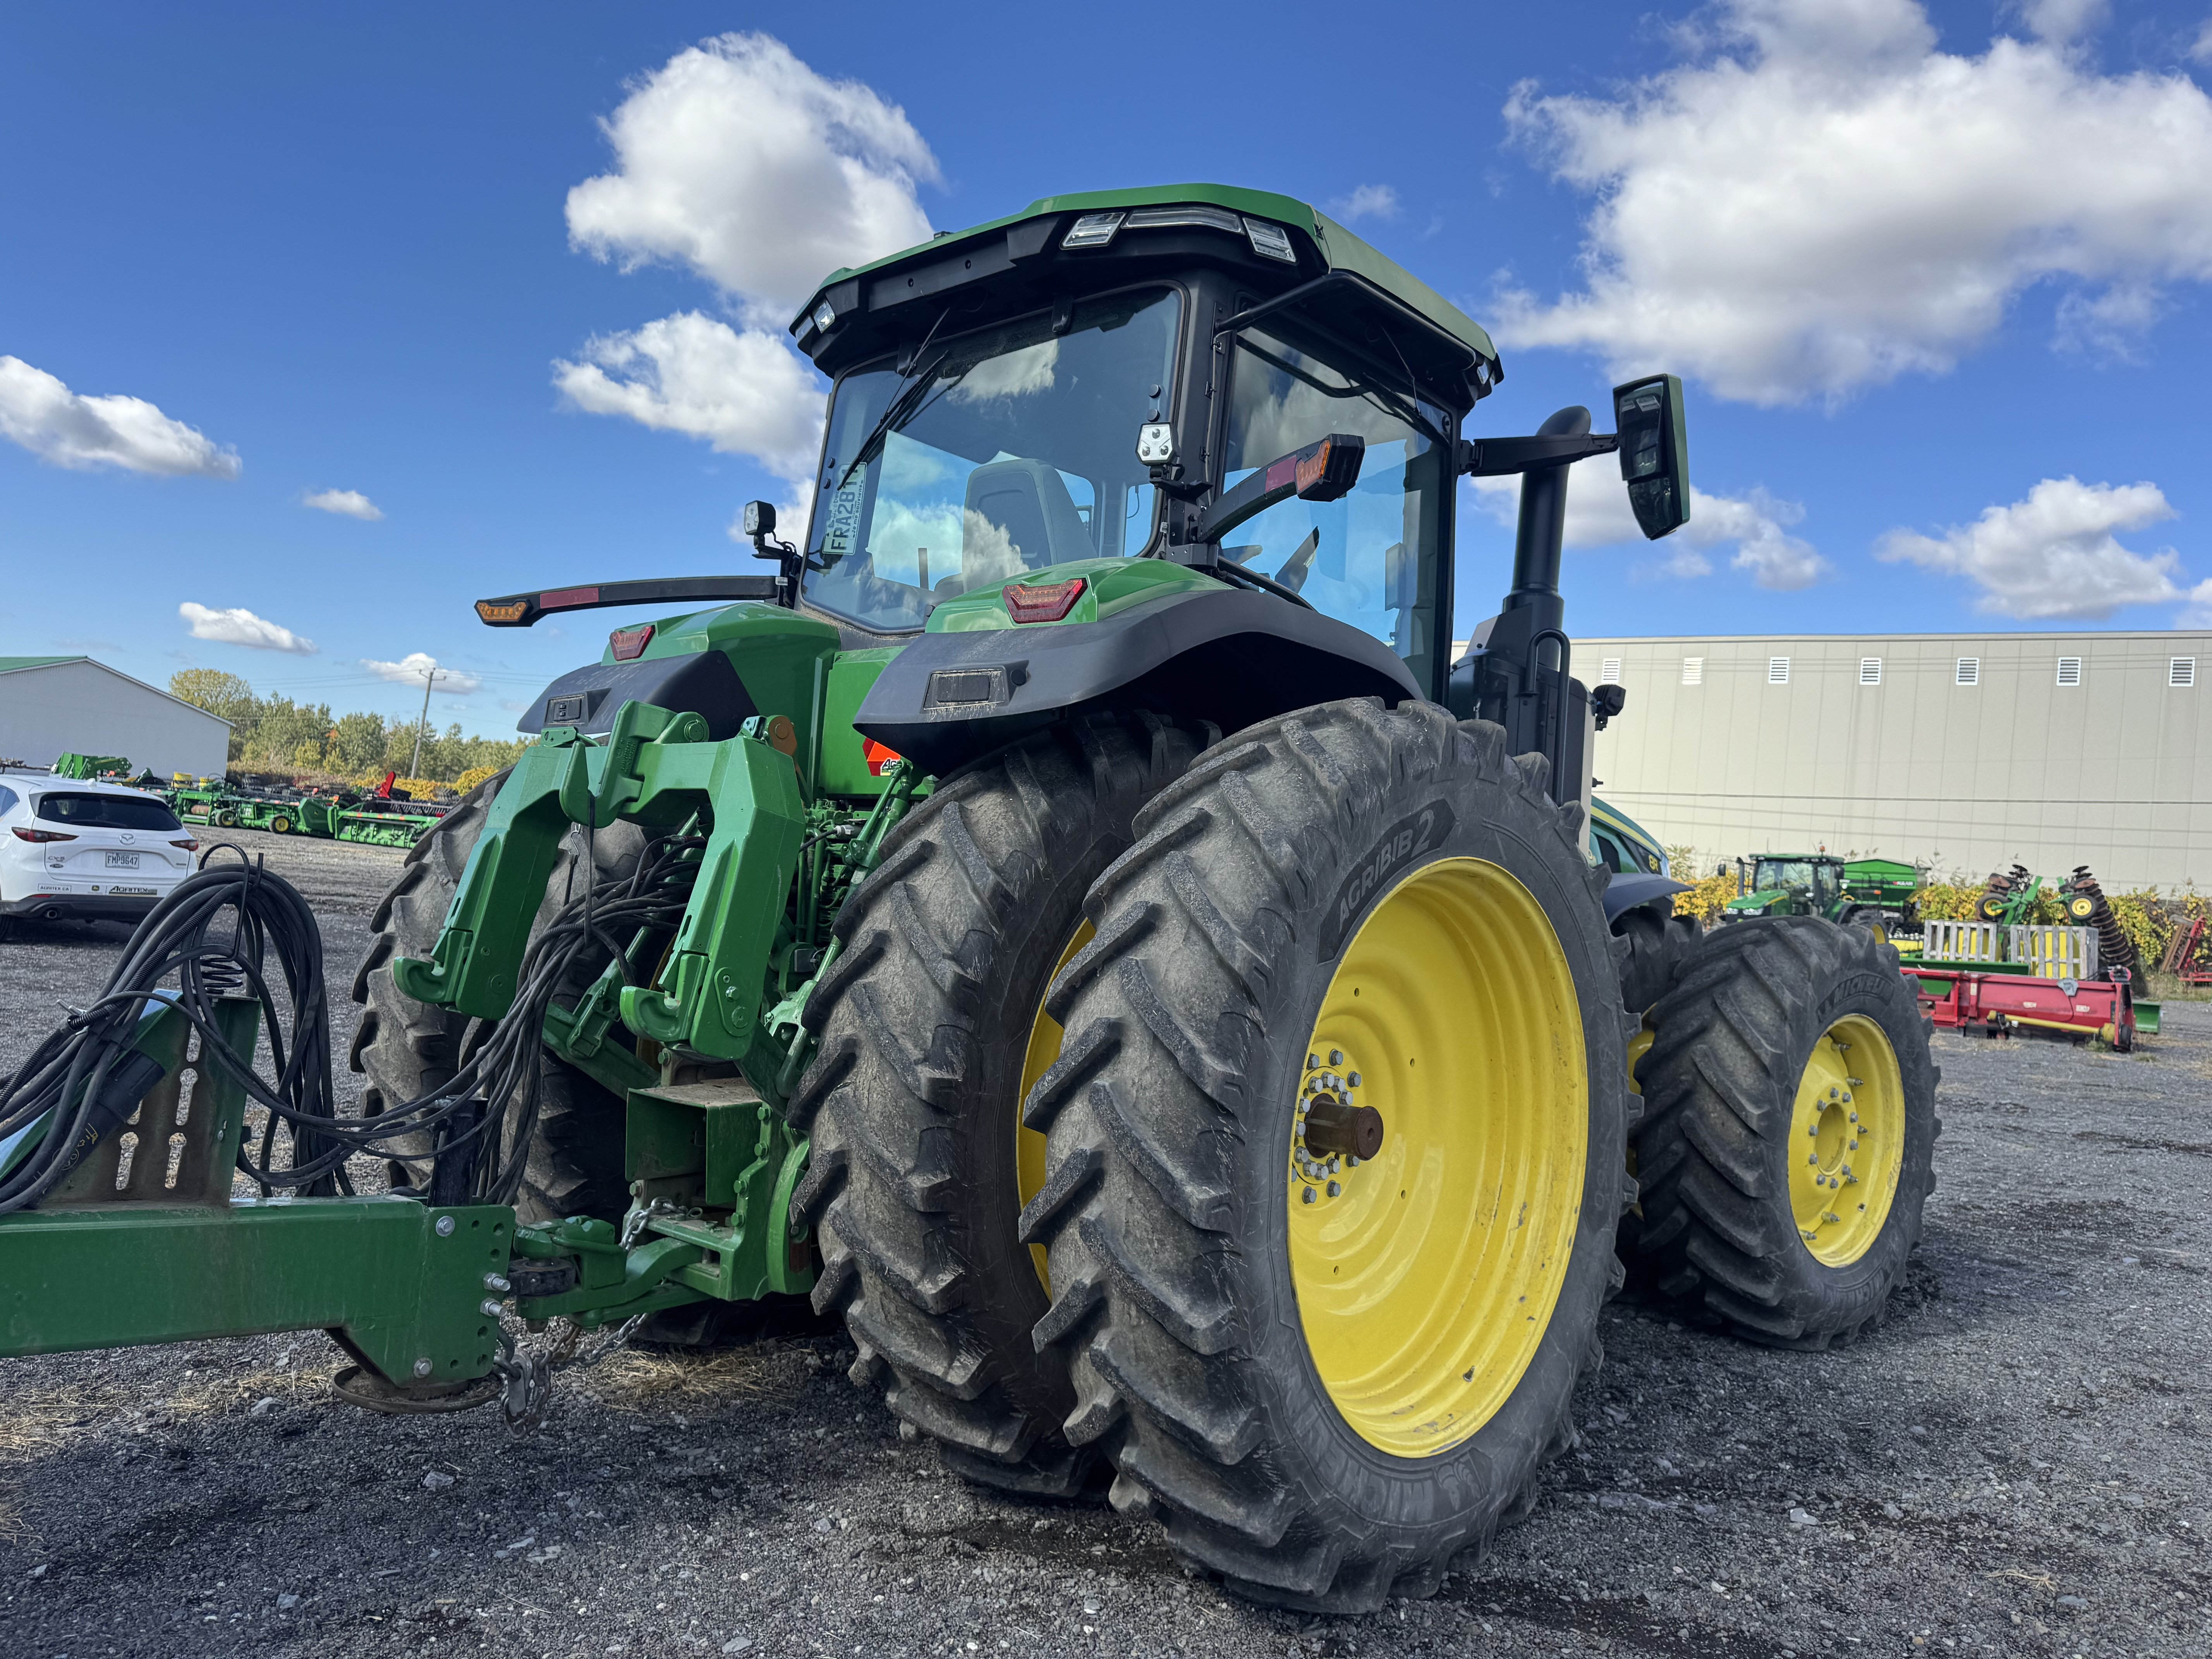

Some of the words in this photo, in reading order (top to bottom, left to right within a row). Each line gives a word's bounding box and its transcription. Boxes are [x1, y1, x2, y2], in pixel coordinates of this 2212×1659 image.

[854, 515, 858, 524] me
[1648, 854, 1658, 871] 8R
[1338, 830, 1413, 934] AGRIBIB
[1410, 809, 1435, 859] 2
